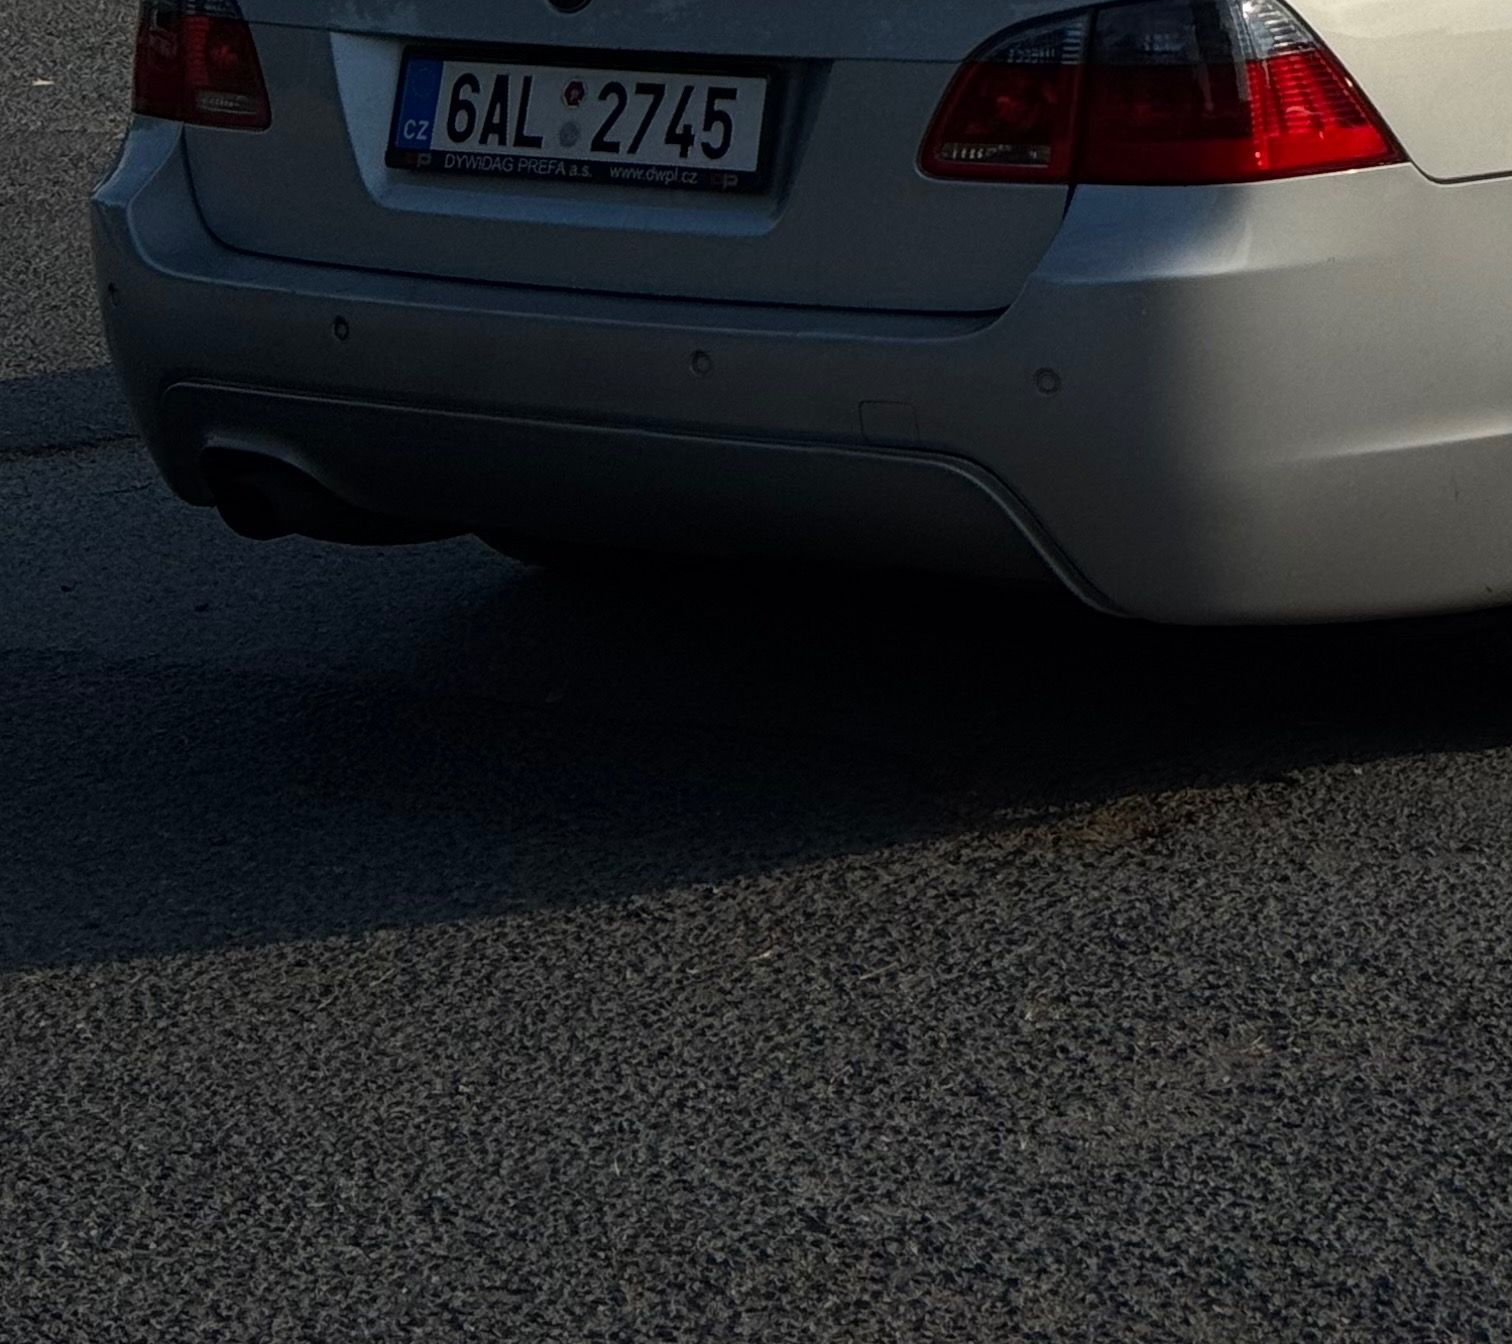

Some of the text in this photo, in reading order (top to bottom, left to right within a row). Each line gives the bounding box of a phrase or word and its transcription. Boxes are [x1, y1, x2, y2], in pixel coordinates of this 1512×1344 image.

[446, 72, 739, 160] 6AL 2745
[402, 118, 428, 141] CZ
[444, 153, 514, 173] DYWIDAG
[517, 158, 566, 177] PREFA
[568, 165, 593, 178] a.s.
